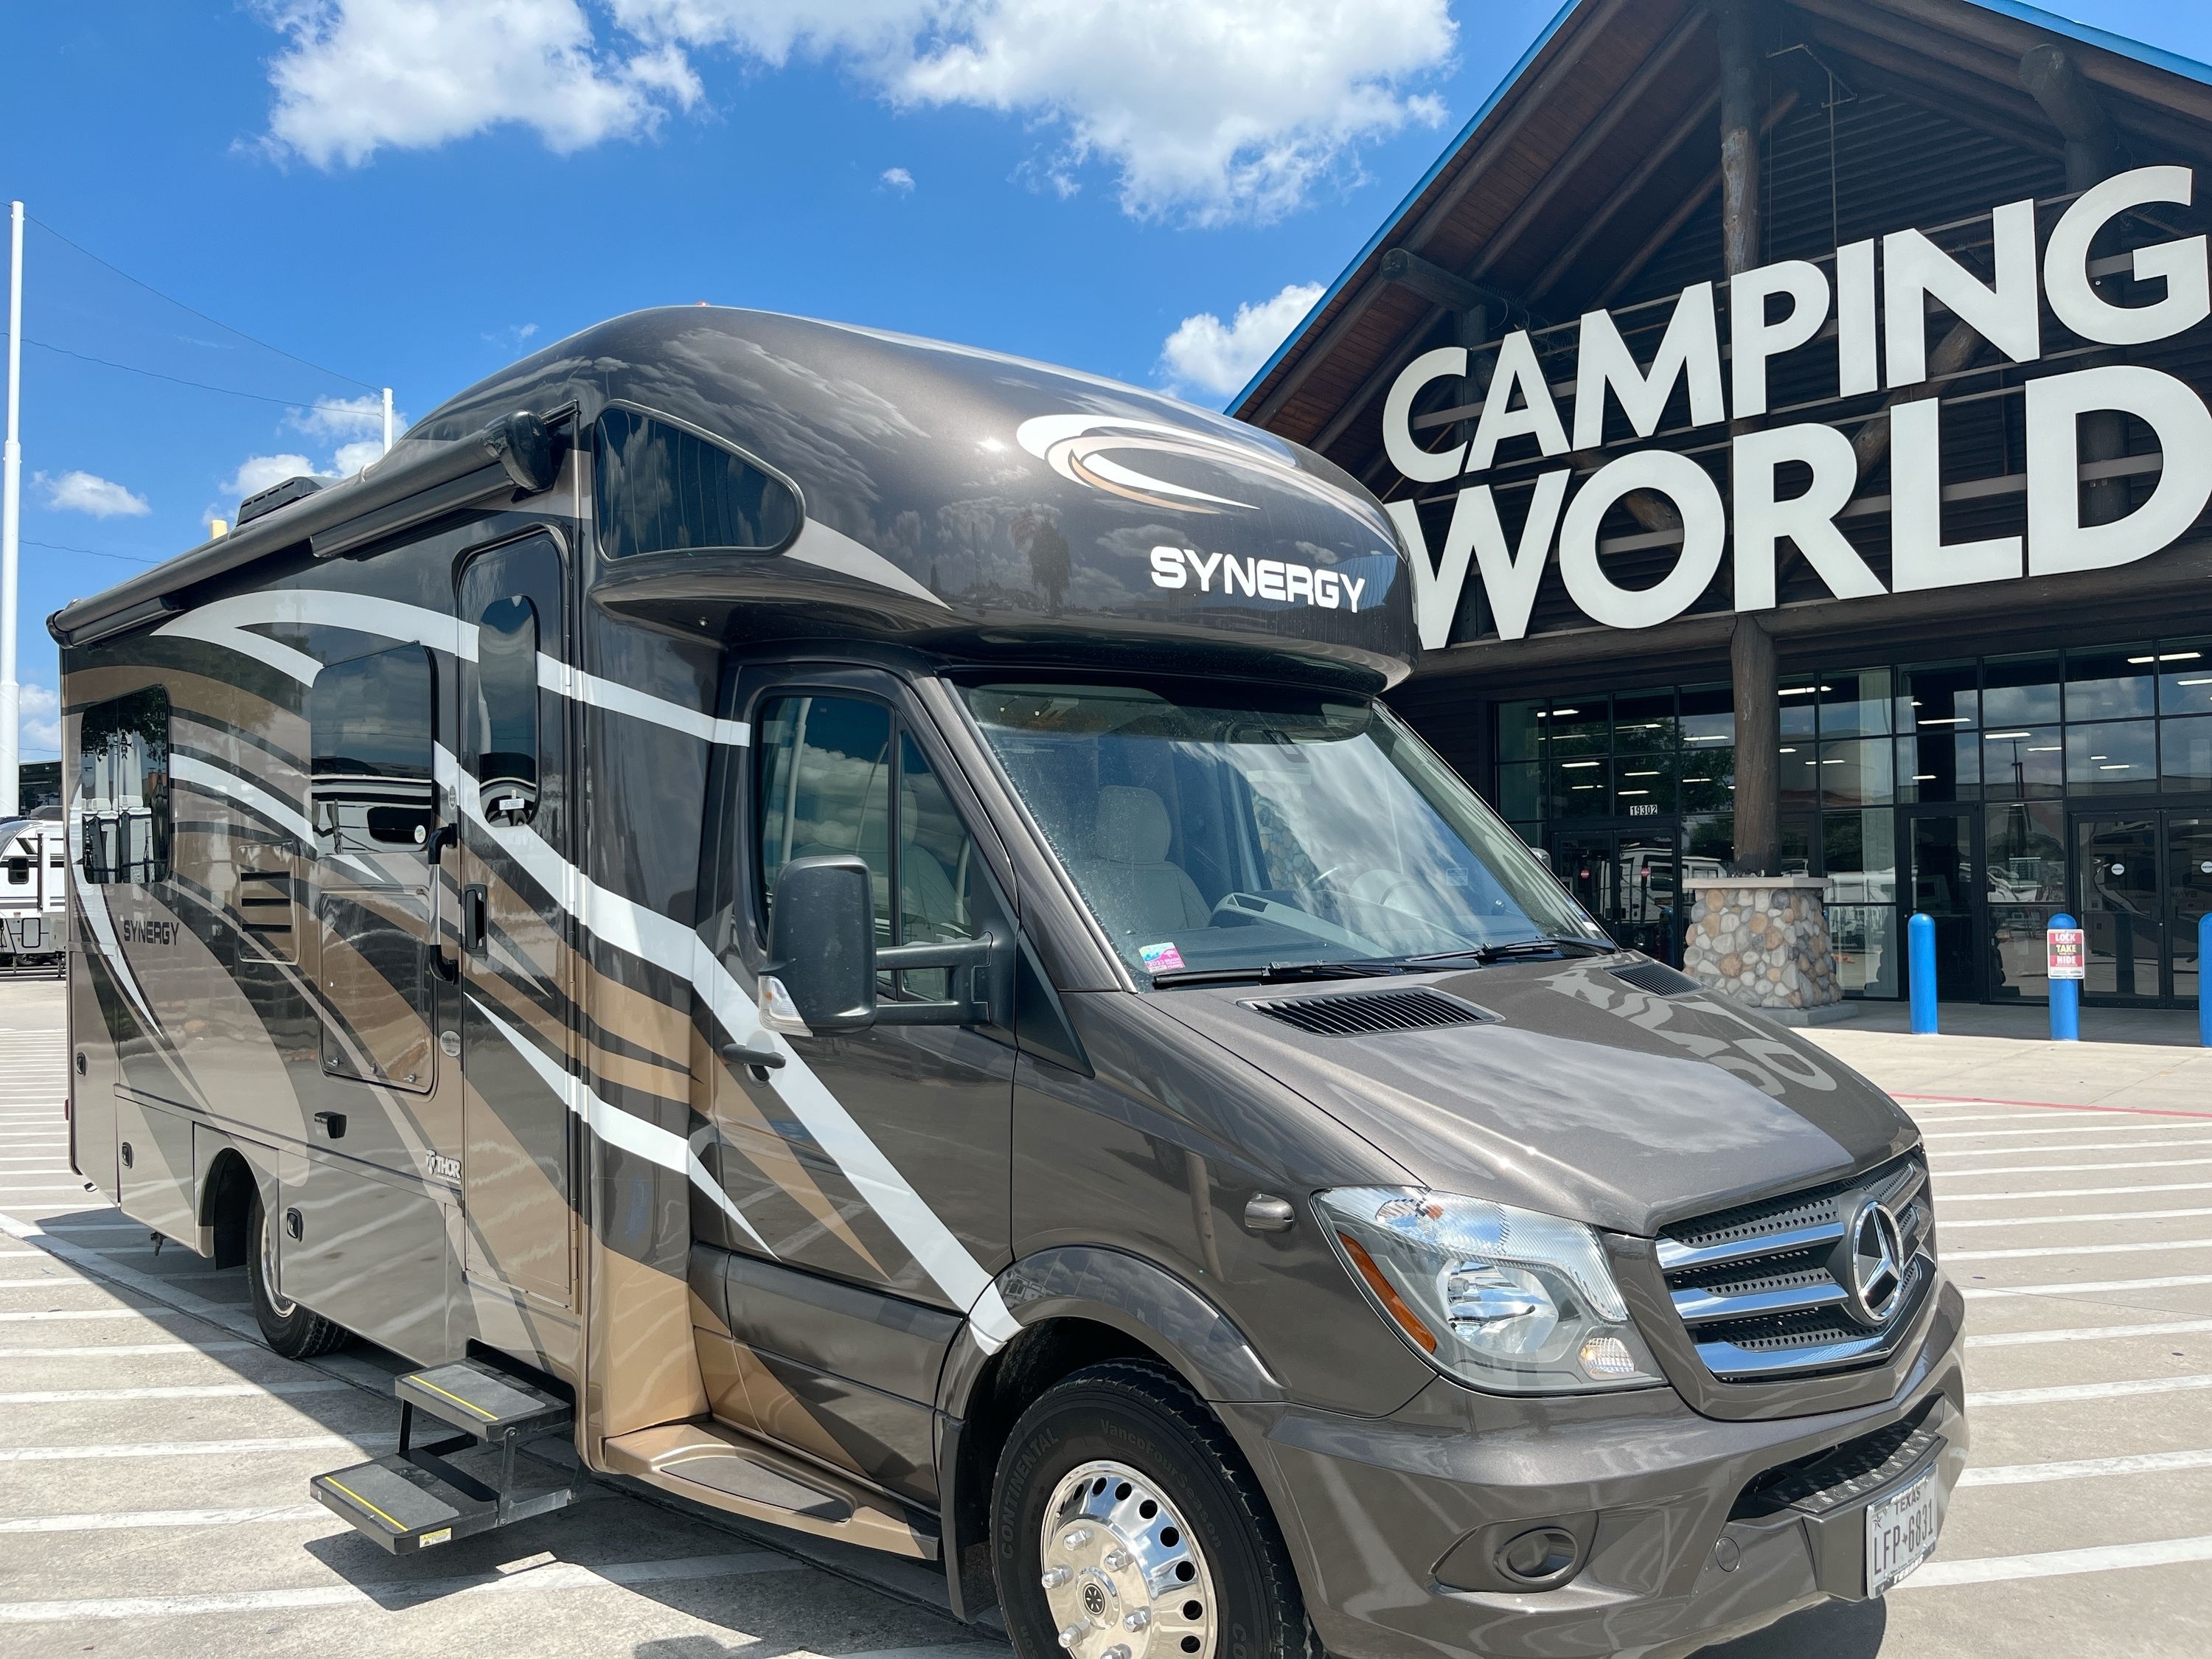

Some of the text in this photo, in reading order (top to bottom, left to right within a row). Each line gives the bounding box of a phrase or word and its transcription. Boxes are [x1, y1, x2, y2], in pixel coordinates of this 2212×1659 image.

[1382, 164, 2212, 483] CAMPING
[1384, 364, 2212, 650] WORLD
[1150, 545, 1366, 613] SYNERGY
[1631, 804, 1658, 815] 19302
[123, 919, 180, 946] SYNERGY
[2054, 933, 2076, 942] LOCK
[2056, 944, 2076, 953] TAKE
[2056, 955, 2076, 964] HIDE
[435, 1155, 462, 1179] THOR
[1001, 1427, 1060, 1559] CONTINENTAL
[1894, 1486, 1921, 1516] TEXAS
[1874, 1498, 1933, 1576] LFP 6831
